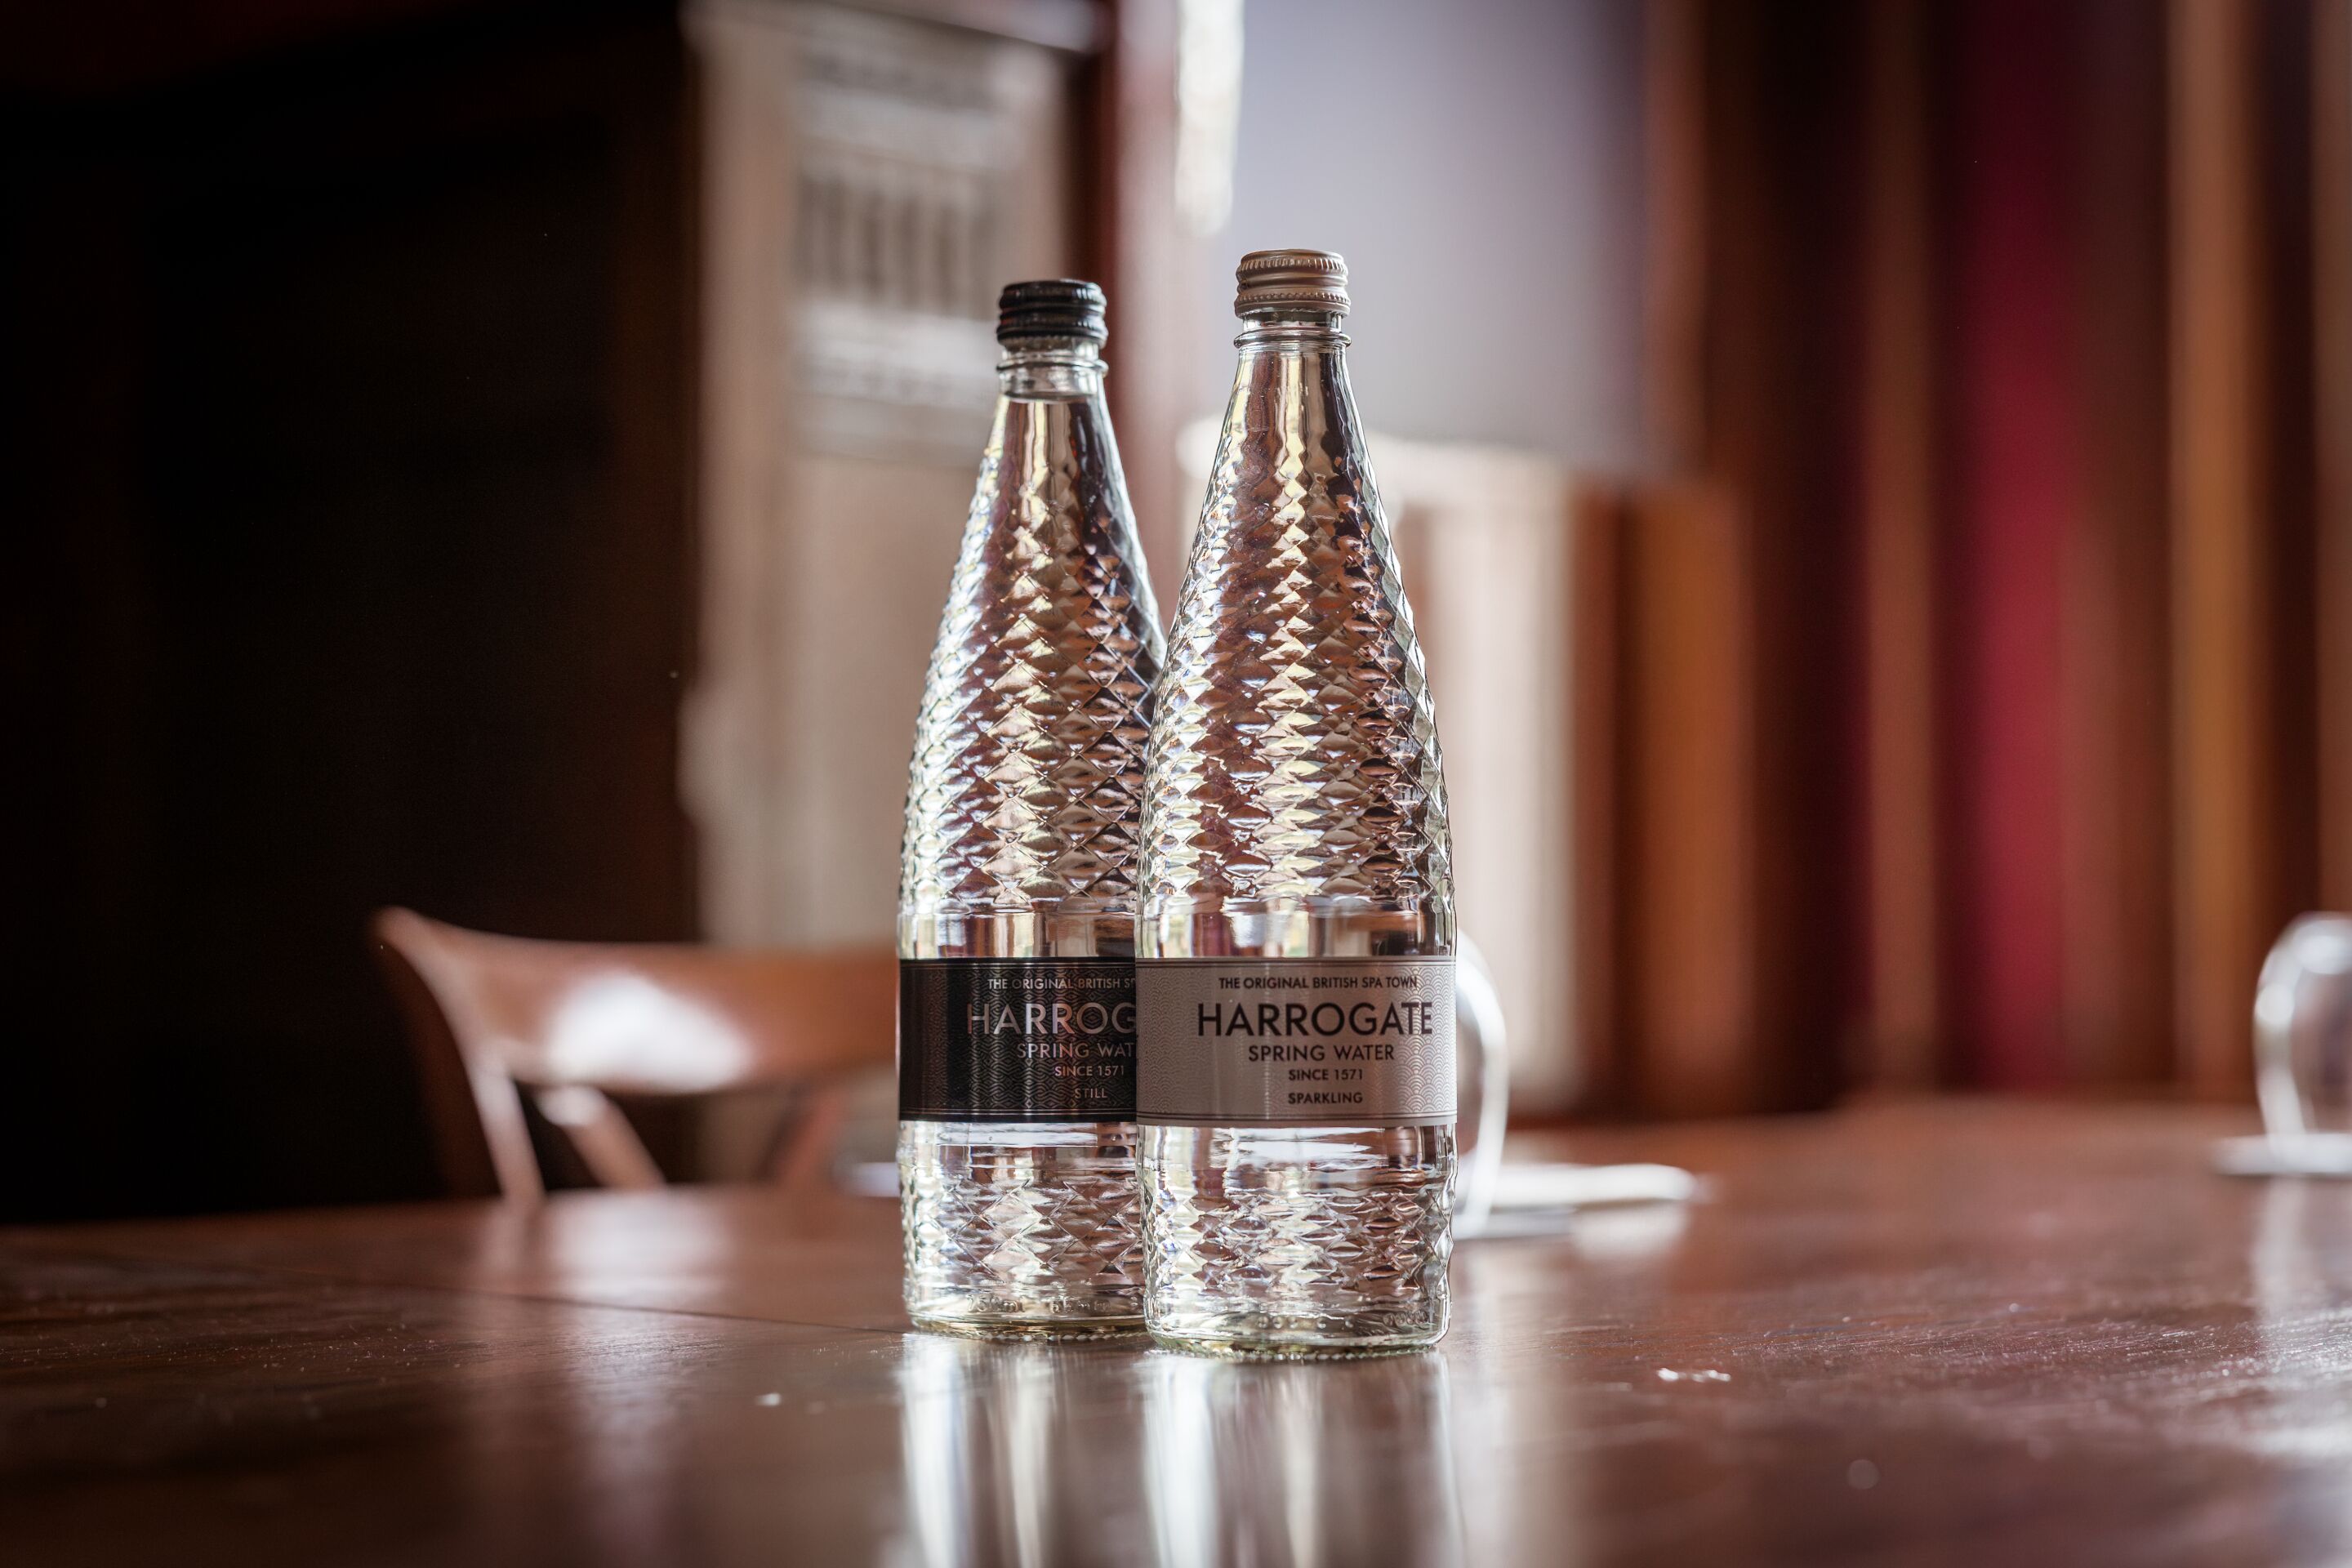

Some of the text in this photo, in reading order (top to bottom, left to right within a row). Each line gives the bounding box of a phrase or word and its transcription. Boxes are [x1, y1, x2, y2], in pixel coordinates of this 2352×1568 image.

[988, 978, 1008, 990] THE
[1012, 978, 1074, 990] ORIGINAL
[1078, 977, 1120, 989] BRITISH
[1219, 976, 1417, 990] THE ORIGINAL BRITISH SPA TOWN
[1197, 1001, 1432, 1036] HARROGATE
[1017, 1042, 1089, 1058] SPRING
[1249, 1045, 1395, 1062] SPRING WATER
[1054, 1064, 1125, 1076] SINCE 1571
[1288, 1068, 1363, 1081] SINCE 1571
[1074, 1087, 1107, 1099] STILL
[1287, 1092, 1363, 1105] SPARKLING
